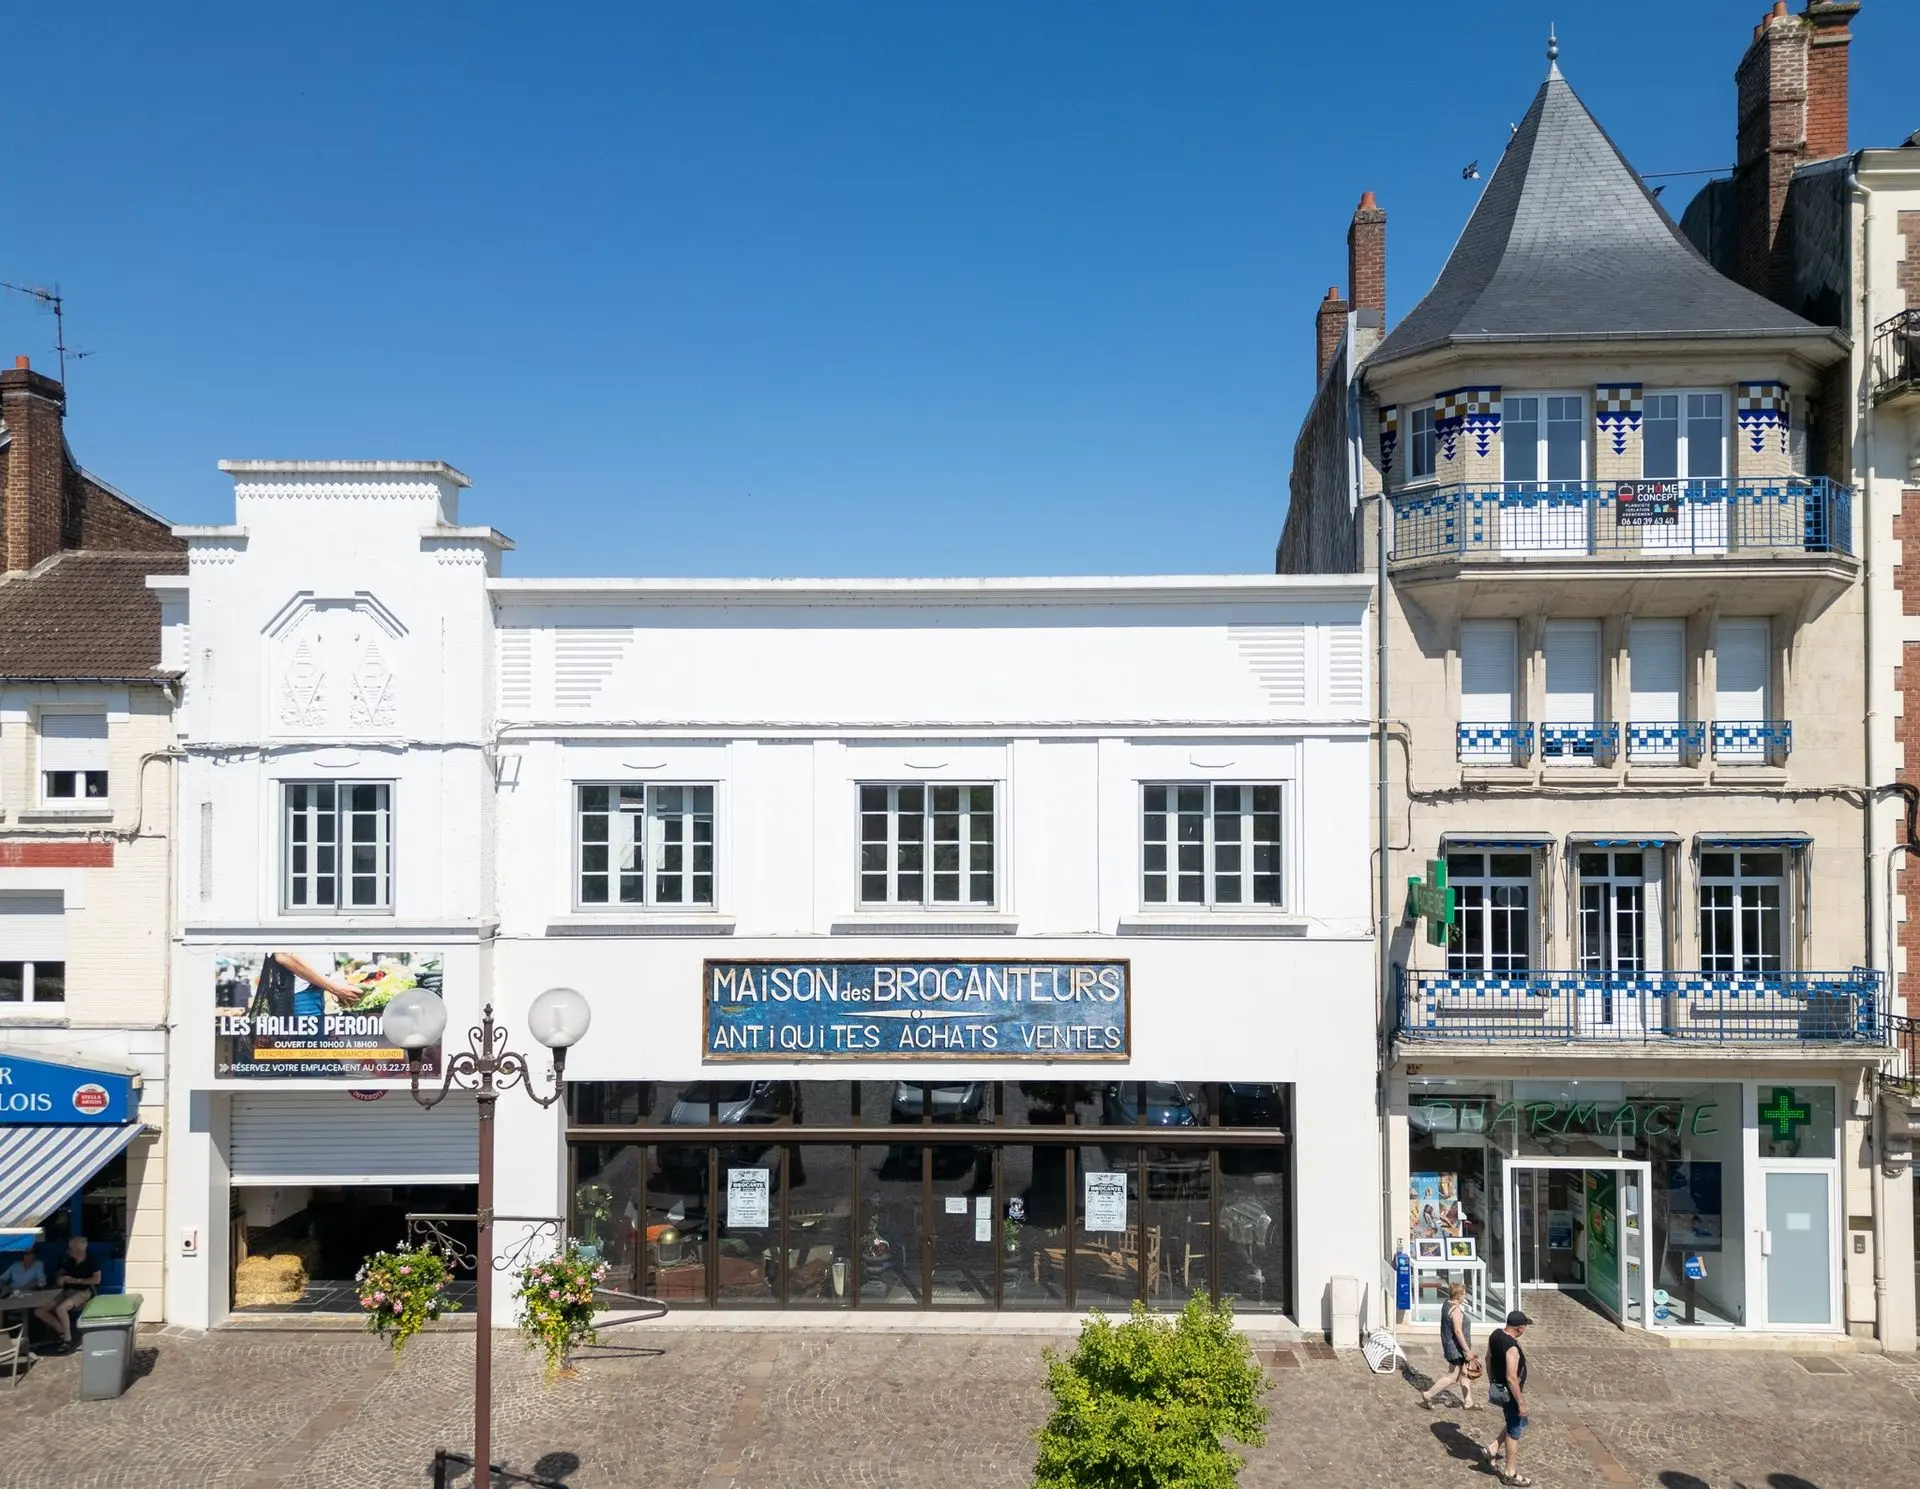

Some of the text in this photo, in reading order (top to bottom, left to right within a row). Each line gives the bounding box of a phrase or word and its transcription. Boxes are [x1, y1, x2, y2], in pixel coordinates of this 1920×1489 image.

[1637, 493, 1678, 502] CONCEPT
[840, 982, 871, 1002] des
[874, 967, 1121, 1002] BROCANTEURS
[220, 1015, 251, 1036] LES
[257, 1015, 319, 1036] HALLES
[346, 1038, 353, 1048] À
[899, 1025, 999, 1050] ACHATS
[1021, 1025, 1121, 1050] VENTES
[231, 1062, 270, 1072] RÉSERVEZ
[273, 1064, 298, 1072] VOTRE
[301, 1064, 361, 1072] EMPLACEMENT
[363, 1064, 374, 1072] AU
[1423, 1102, 1721, 1137] PHARMACIE
